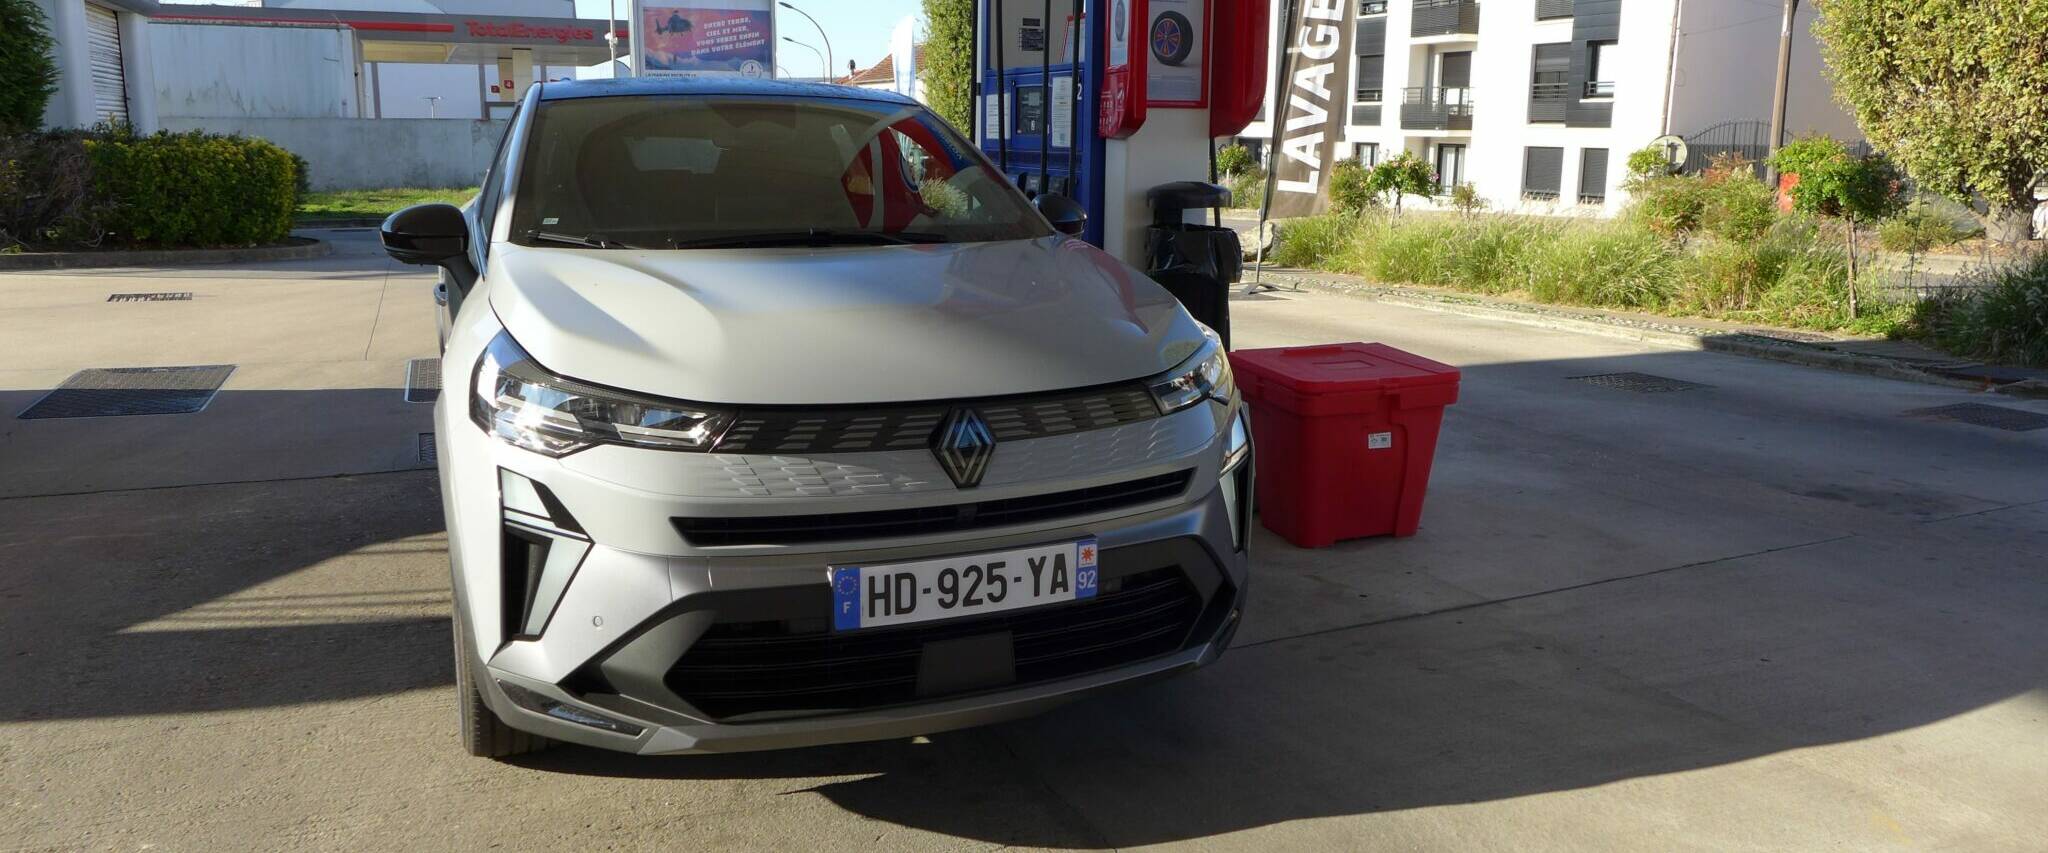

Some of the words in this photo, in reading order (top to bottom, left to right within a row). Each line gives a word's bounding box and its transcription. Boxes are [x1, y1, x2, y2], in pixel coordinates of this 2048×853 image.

[465, 20, 593, 43] TotalEnergies
[706, 29, 721, 37] CIEL
[712, 44, 734, 52] VOTRE
[1077, 83, 1082, 100] 2
[1277, 0, 1345, 194] LAVAGE
[868, 553, 1069, 618] HD-925-YA
[1078, 570, 1096, 589] 92
[843, 602, 851, 614] F
